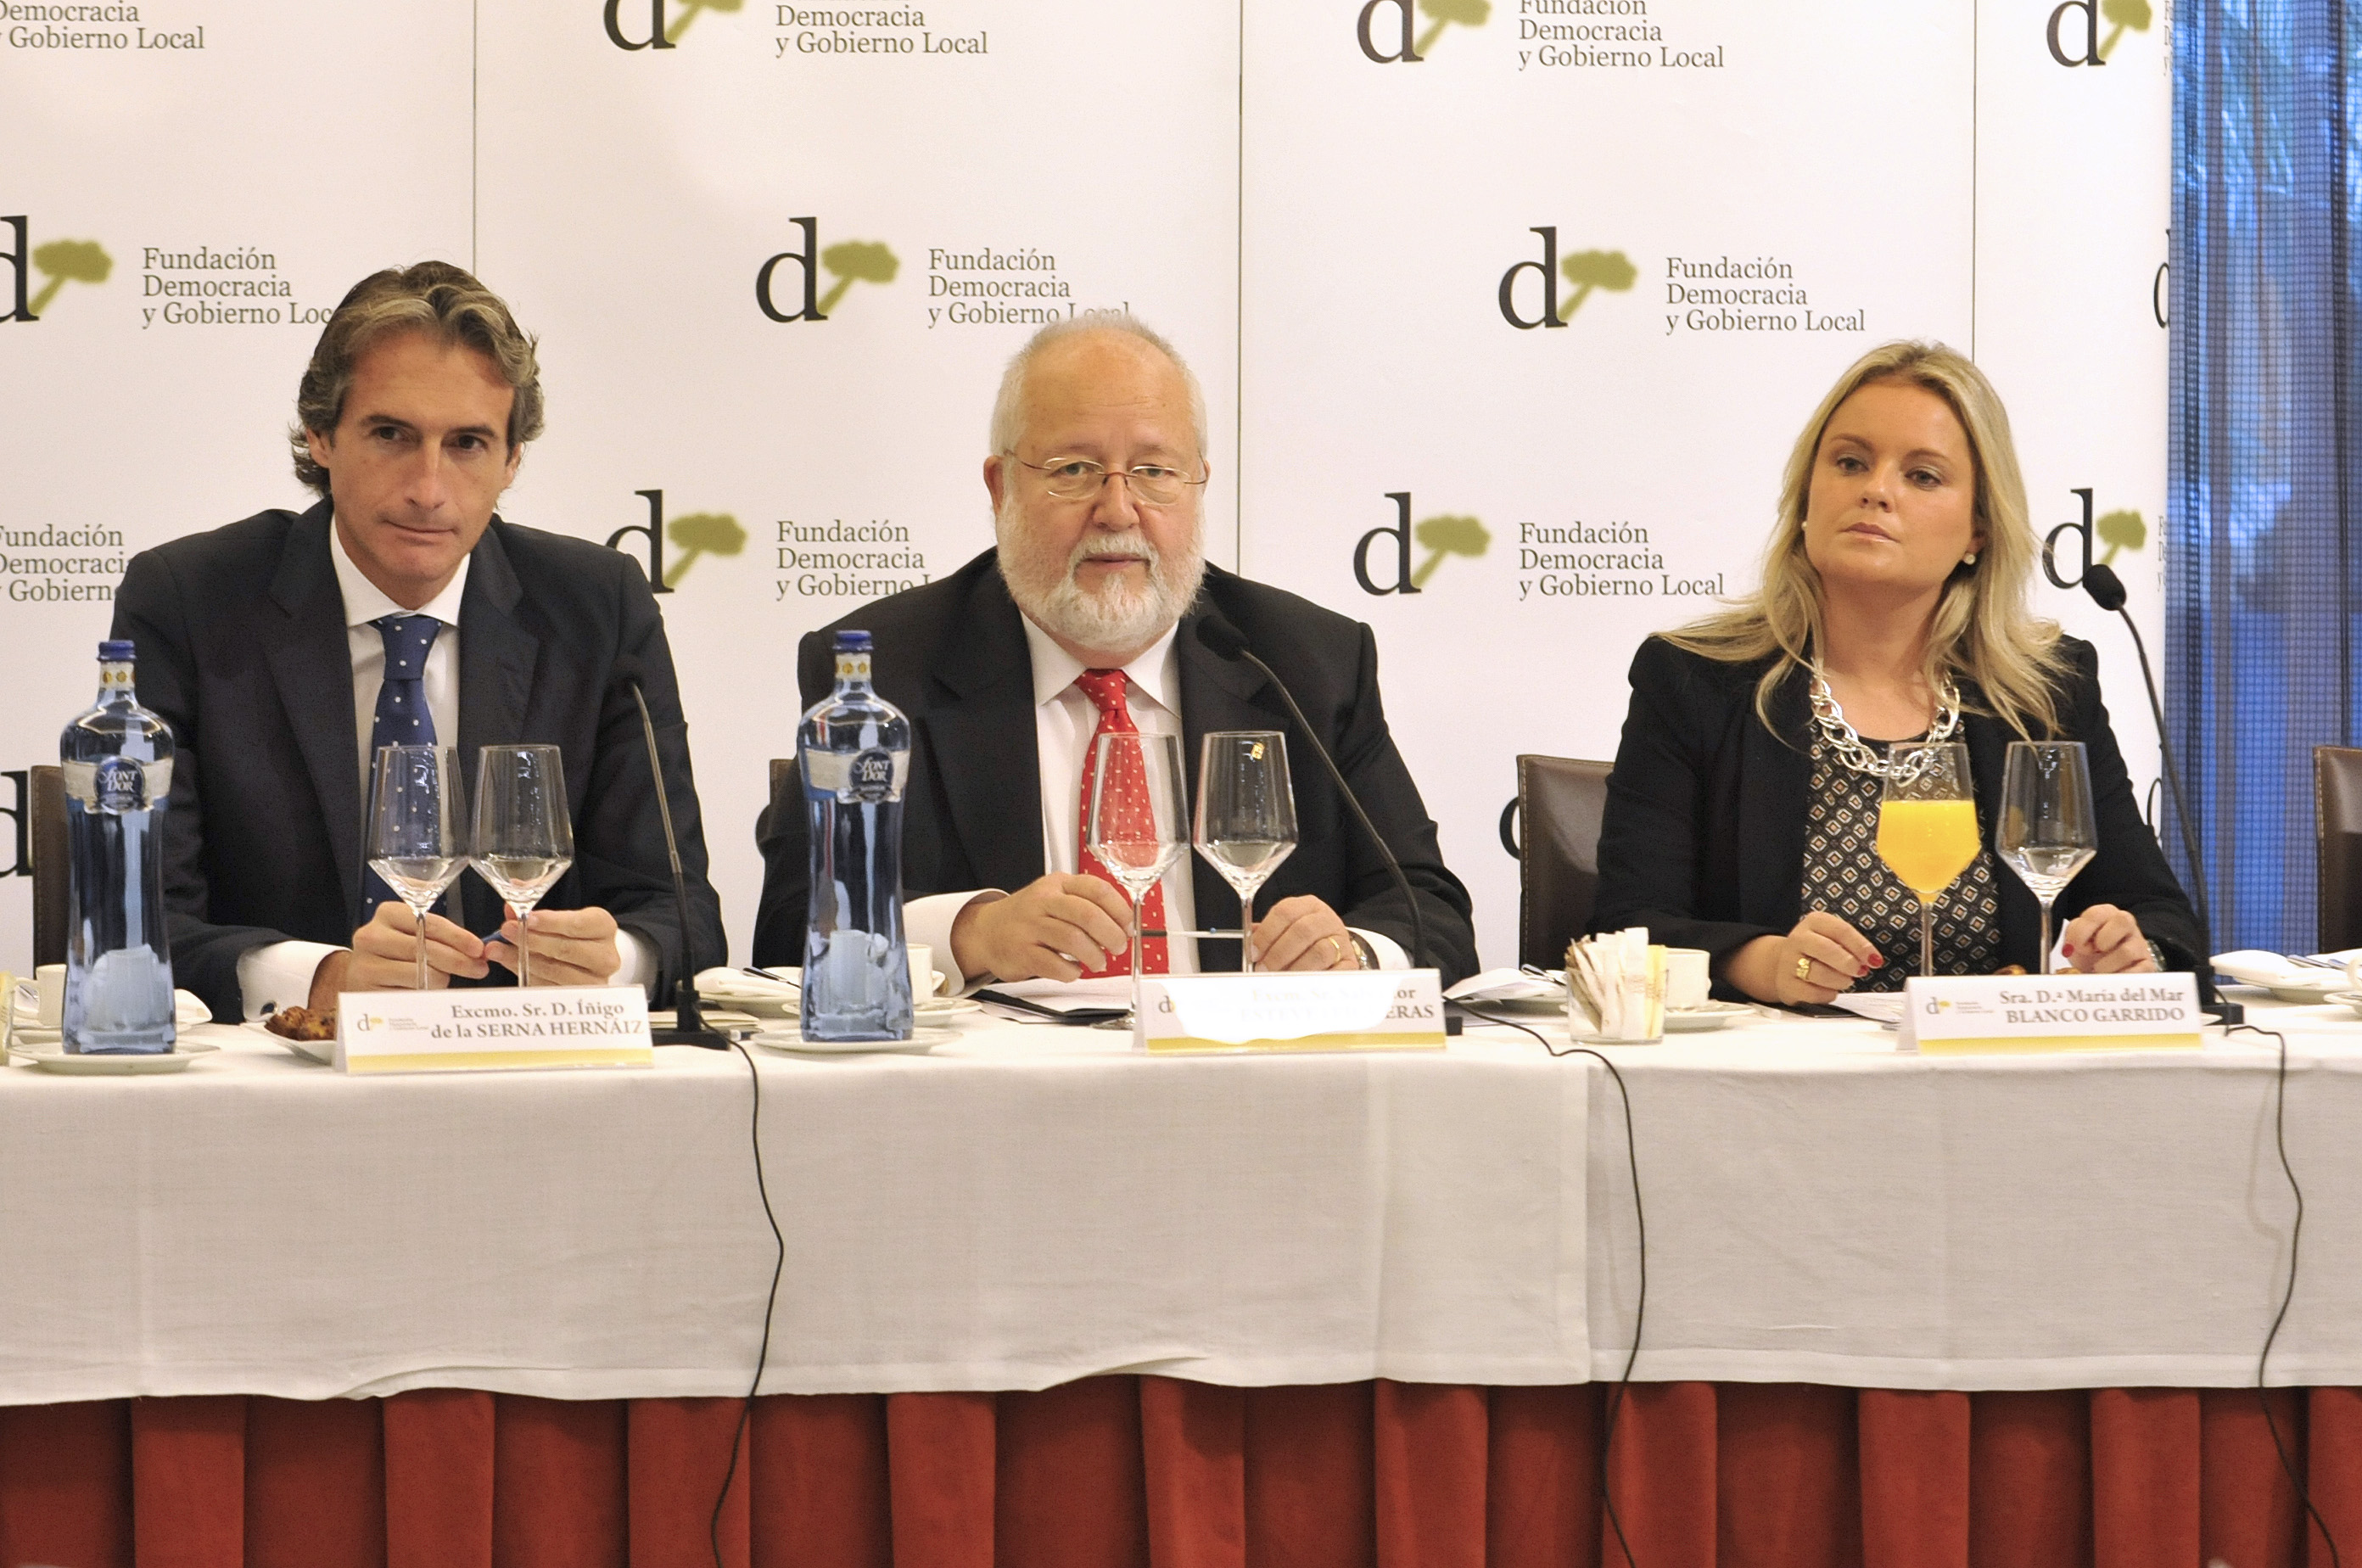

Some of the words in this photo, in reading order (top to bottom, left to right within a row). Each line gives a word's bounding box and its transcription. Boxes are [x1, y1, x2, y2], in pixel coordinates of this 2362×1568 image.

[775, 4, 926, 27] Democracia
[8, 25, 128, 49] Gobierno
[137, 25, 205, 49] Local
[1519, 19, 1663, 42] Democracia
[775, 37, 790, 59] y
[796, 30, 914, 53] Gobierno
[922, 31, 988, 54] Local
[1519, 51, 1531, 71] y
[1538, 44, 1652, 67] Gobierno
[1660, 45, 1724, 68] Local
[143, 245, 277, 270] Fundación
[755, 216, 828, 323] d
[928, 247, 1056, 271] Fundación
[1666, 255, 1793, 279] Fundación
[143, 274, 292, 297] Democracia
[928, 275, 1071, 298] Democracia
[1498, 226, 1568, 330] d
[1666, 283, 1807, 305] Democracia
[142, 307, 157, 330] y
[163, 300, 281, 324] Gobierno
[288, 302, 333, 324] Loc
[928, 308, 942, 329] y
[949, 300, 1060, 324] Gobierno
[1666, 315, 1679, 336] y
[1686, 308, 1797, 332] Gobierno
[1805, 309, 1865, 332] Local
[777, 518, 910, 543] Fundación
[1520, 520, 1649, 544] Fundación
[1353, 491, 1422, 596] d
[0, 552, 127, 574] emocraci
[776, 546, 925, 569] Democracia
[1520, 547, 1664, 570] Democracia
[8, 578, 115, 602] Gobiern
[776, 580, 791, 602] y
[797, 573, 914, 596] Gobierno
[1520, 580, 1532, 602] y
[1539, 573, 1654, 596] Gobierno
[1661, 573, 1724, 596] Local
[451, 1004, 518, 1019] Excmo.
[522, 1003, 547, 1017] Sr.
[551, 1001, 573, 1016] D.
[577, 998, 625, 1019] Íñigo
[1999, 990, 2033, 1005] Sra.
[2067, 988, 2117, 1003] María
[2120, 988, 2146, 1002] del
[2149, 988, 2185, 1002] Mar
[2006, 1008, 2089, 1024] BLANCO
[2092, 1006, 2186, 1022] GARRIDO
[430, 1023, 452, 1039] de
[456, 1024, 473, 1039] la
[476, 1022, 546, 1038] SERNA
[550, 1018, 643, 1036] HERNÁIZ
